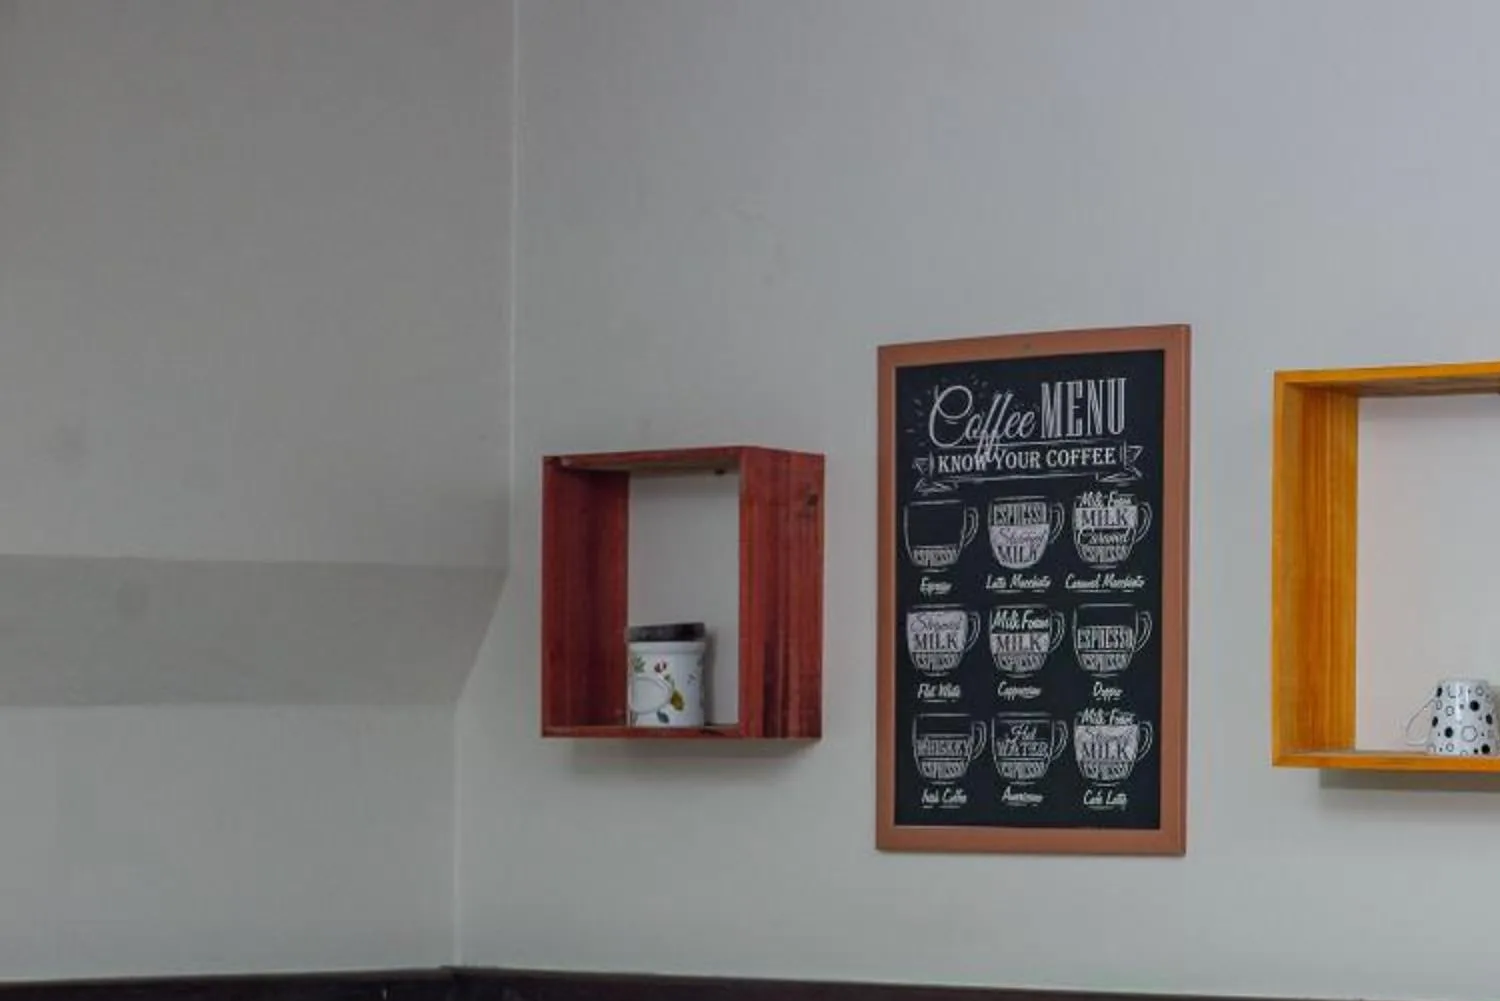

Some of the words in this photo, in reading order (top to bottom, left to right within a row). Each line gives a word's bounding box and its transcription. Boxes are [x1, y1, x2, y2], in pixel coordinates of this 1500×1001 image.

[929, 384, 1036, 464] Coffee
[1040, 377, 1127, 439] MENU
[937, 454, 987, 474] KNOW
[995, 449, 1041, 470] YOUR
[1046, 447, 1117, 466] COFFEE
[1082, 508, 1129, 527] MILK
[994, 609, 1020, 631] Milk
[914, 632, 958, 651] MILK
[996, 634, 1043, 652] MILK
[1078, 628, 1134, 649] ESPRESSO
[997, 739, 1049, 757] WATER
